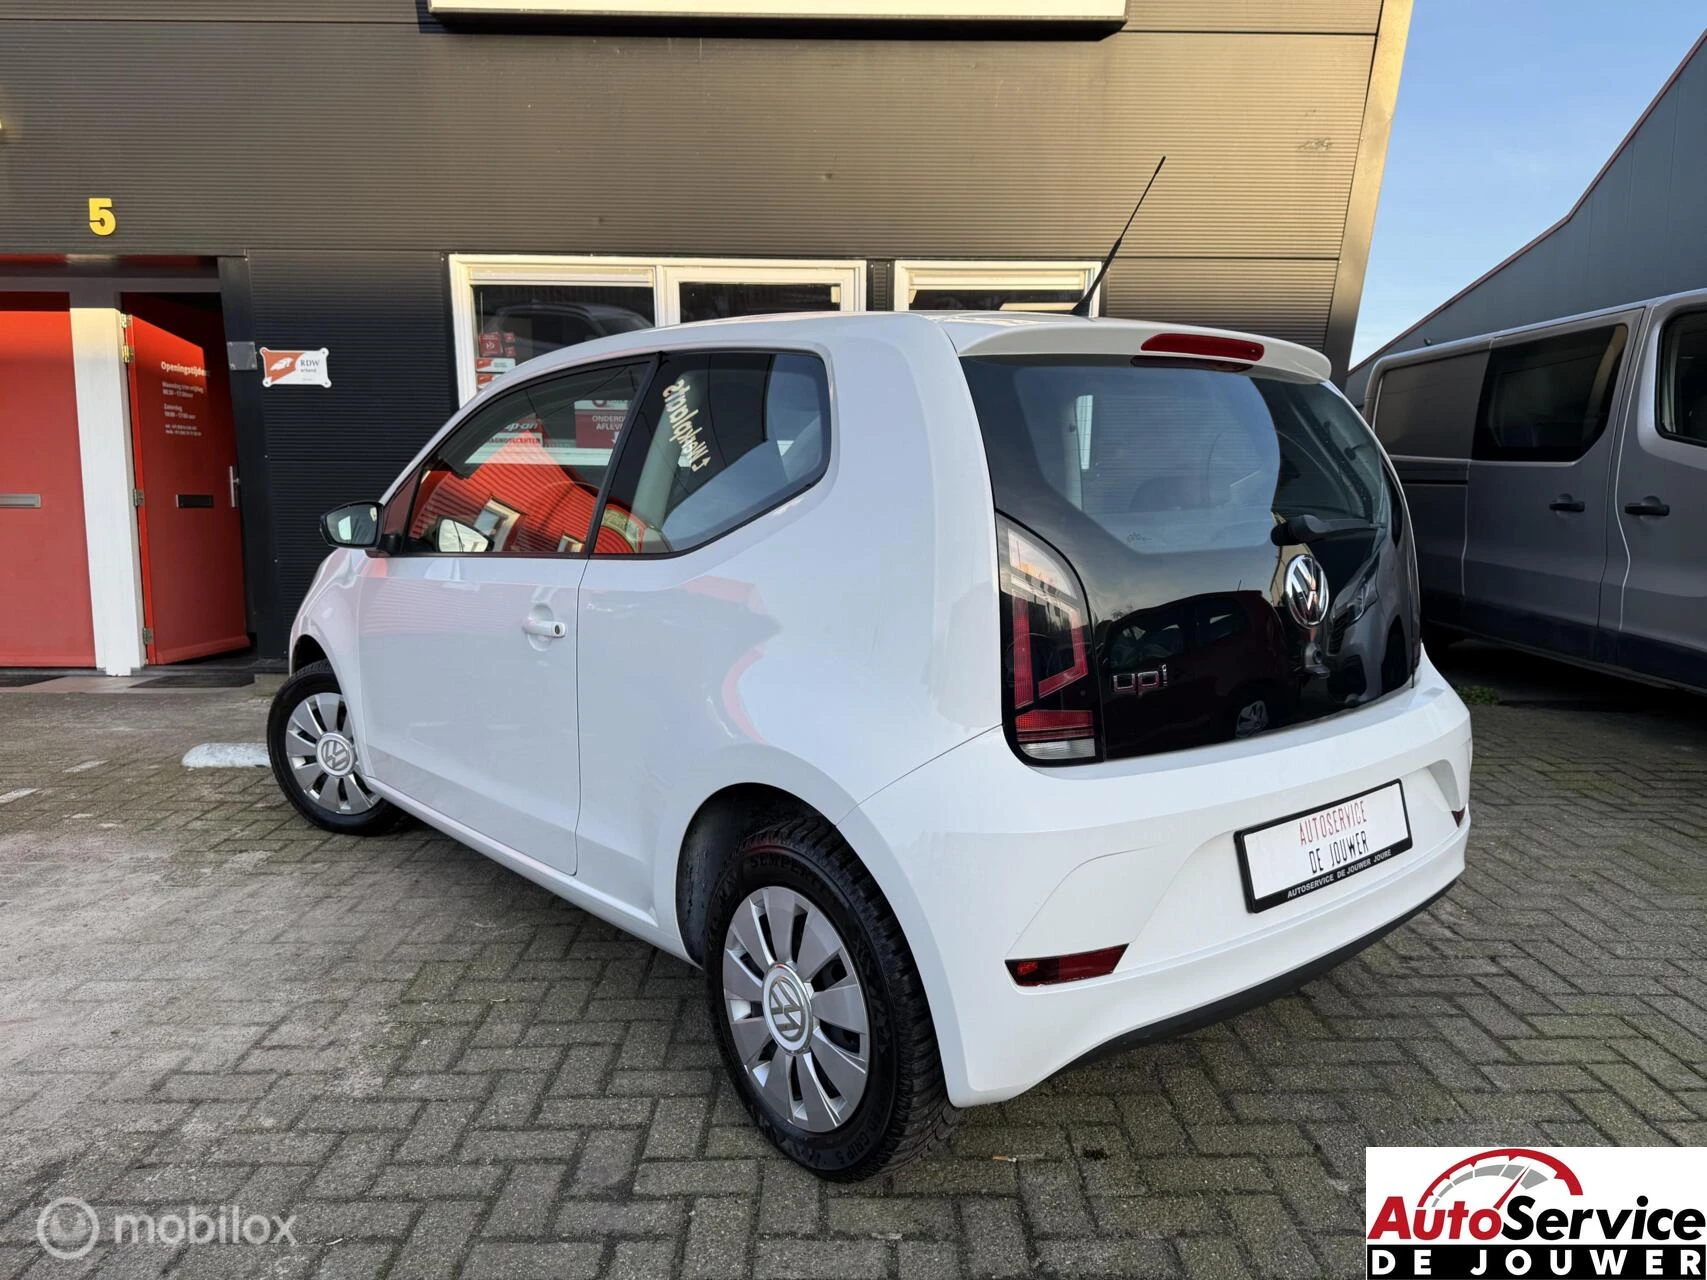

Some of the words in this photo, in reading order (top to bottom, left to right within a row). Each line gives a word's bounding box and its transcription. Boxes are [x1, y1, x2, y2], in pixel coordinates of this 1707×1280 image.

[88, 197, 116, 236] 5
[300, 359, 320, 367] RDW
[1298, 800, 1367, 847] AUTOSERVICE
[1287, 874, 1334, 898] AUTOSERVICE
[1337, 866, 1346, 878] DE
[1346, 858, 1371, 874] JOUWER
[1373, 849, 1392, 863] JOURE
[1308, 848, 1324, 874] DE
[1329, 830, 1369, 866] JOUWER
